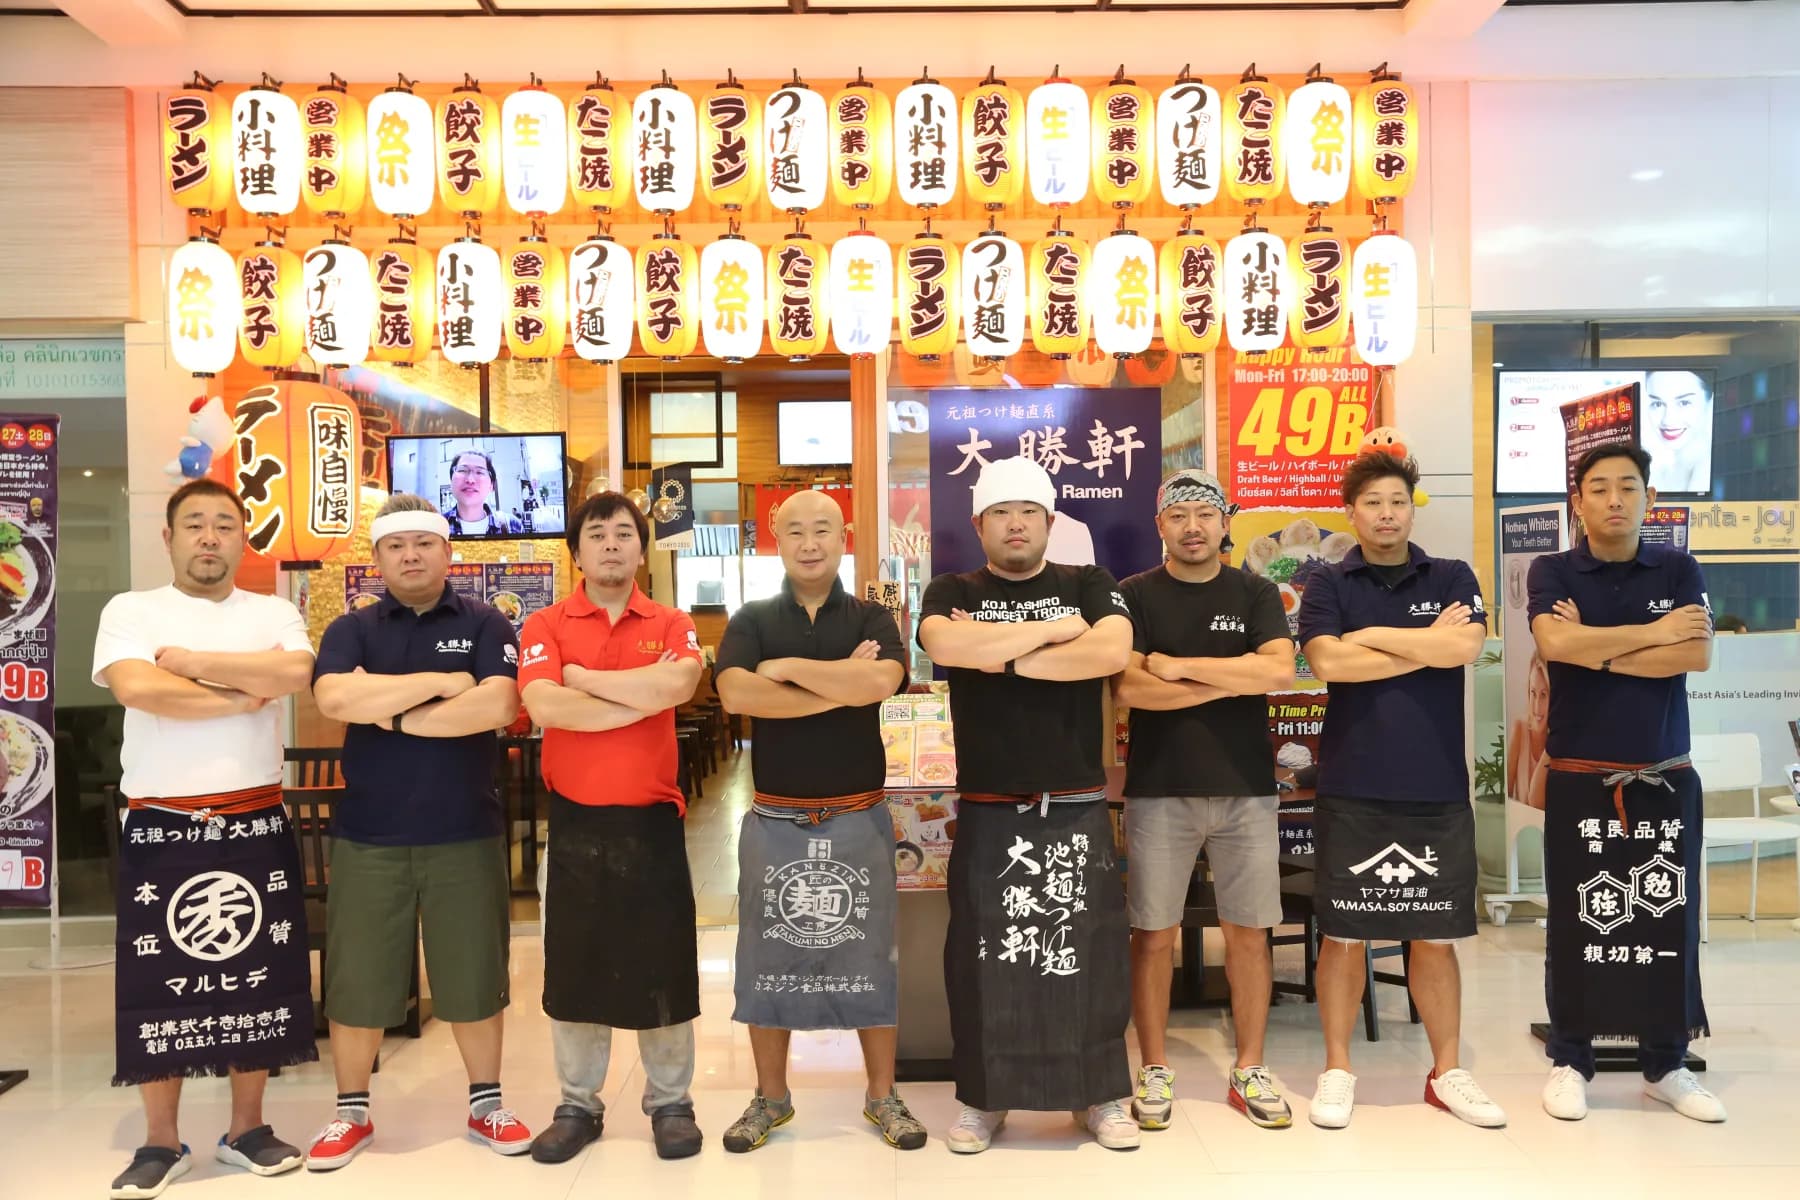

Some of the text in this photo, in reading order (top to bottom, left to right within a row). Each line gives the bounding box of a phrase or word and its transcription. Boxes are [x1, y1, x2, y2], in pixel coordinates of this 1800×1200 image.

[168, 97, 207, 191] ラーメン
[238, 99, 276, 195] 小料理
[306, 101, 336, 194] 営業中
[376, 110, 409, 188] 祭
[445, 103, 483, 194] 餃子
[576, 97, 613, 191] たこ焼
[638, 98, 675, 194] 小料理
[709, 96, 746, 188] ラーメン
[769, 90, 805, 193] つけ麺
[838, 97, 868, 187] 営業中
[908, 93, 946, 190] 小料理
[972, 96, 1009, 185] 餃子
[1108, 96, 1138, 186] 営業中
[1170, 85, 1211, 190] つけ麺
[1236, 89, 1273, 184] たこ焼
[1311, 100, 1345, 176] 祭
[1375, 91, 1407, 178] 営業中
[176, 266, 213, 341] 祭
[241, 257, 278, 350] 餃子
[305, 250, 344, 351] つけ麺
[376, 253, 413, 347] たこ焼
[440, 253, 475, 348] 小料理
[512, 254, 544, 342] 営業中
[573, 244, 610, 345] つけ麺
[645, 250, 682, 341] 餃子
[714, 259, 750, 334] 祭
[777, 247, 814, 340] たこ焼
[908, 247, 948, 338] ラーメン
[970, 240, 1009, 343] つけ麺
[1044, 243, 1080, 337] たこ焼
[1116, 256, 1151, 330] 祭
[1182, 249, 1217, 338] 餃子
[1242, 242, 1280, 337] 小料理
[1302, 242, 1342, 334] ラーメン
[946, 406, 1055, 420] 元祖つけ麺直系
[1235, 368, 1368, 383] Mon-Fri 17:00-20:00
[1339, 386, 1367, 402] ALL
[319, 418, 349, 523] 味自慢
[946, 419, 1145, 480] 大勝軒
[1062, 485, 1123, 500] Ramen
[1238, 461, 1279, 472] 生ビール
[1288, 460, 1338, 471] ハイボール
[1238, 475, 1260, 483] Draft
[1262, 475, 1282, 483] Beer
[1289, 474, 1327, 485] Highball
[1505, 517, 1559, 535] Nothing Whitens
[981, 599, 1007, 610] KOJI
[1032, 605, 1081, 619] TROOPS
[0, 661, 48, 701] 9B
[1279, 705, 1307, 717] Time
[1714, 691, 1741, 699] Asia's
[1743, 690, 1782, 700] Leading
[1278, 722, 1294, 736] Fri
[130, 816, 284, 844] 元祖つけ麺 大勝軒
[1578, 818, 1685, 839] 優良品質
[133, 882, 162, 956] 本位
[267, 870, 292, 945] 品質
[1360, 887, 1429, 899] ヤマサ醤油
[1412, 901, 1453, 912] SAUCE
[165, 966, 268, 996] マルヒデ
[1584, 944, 1678, 965] 親切第一
[146, 1040, 169, 1054] 電話
